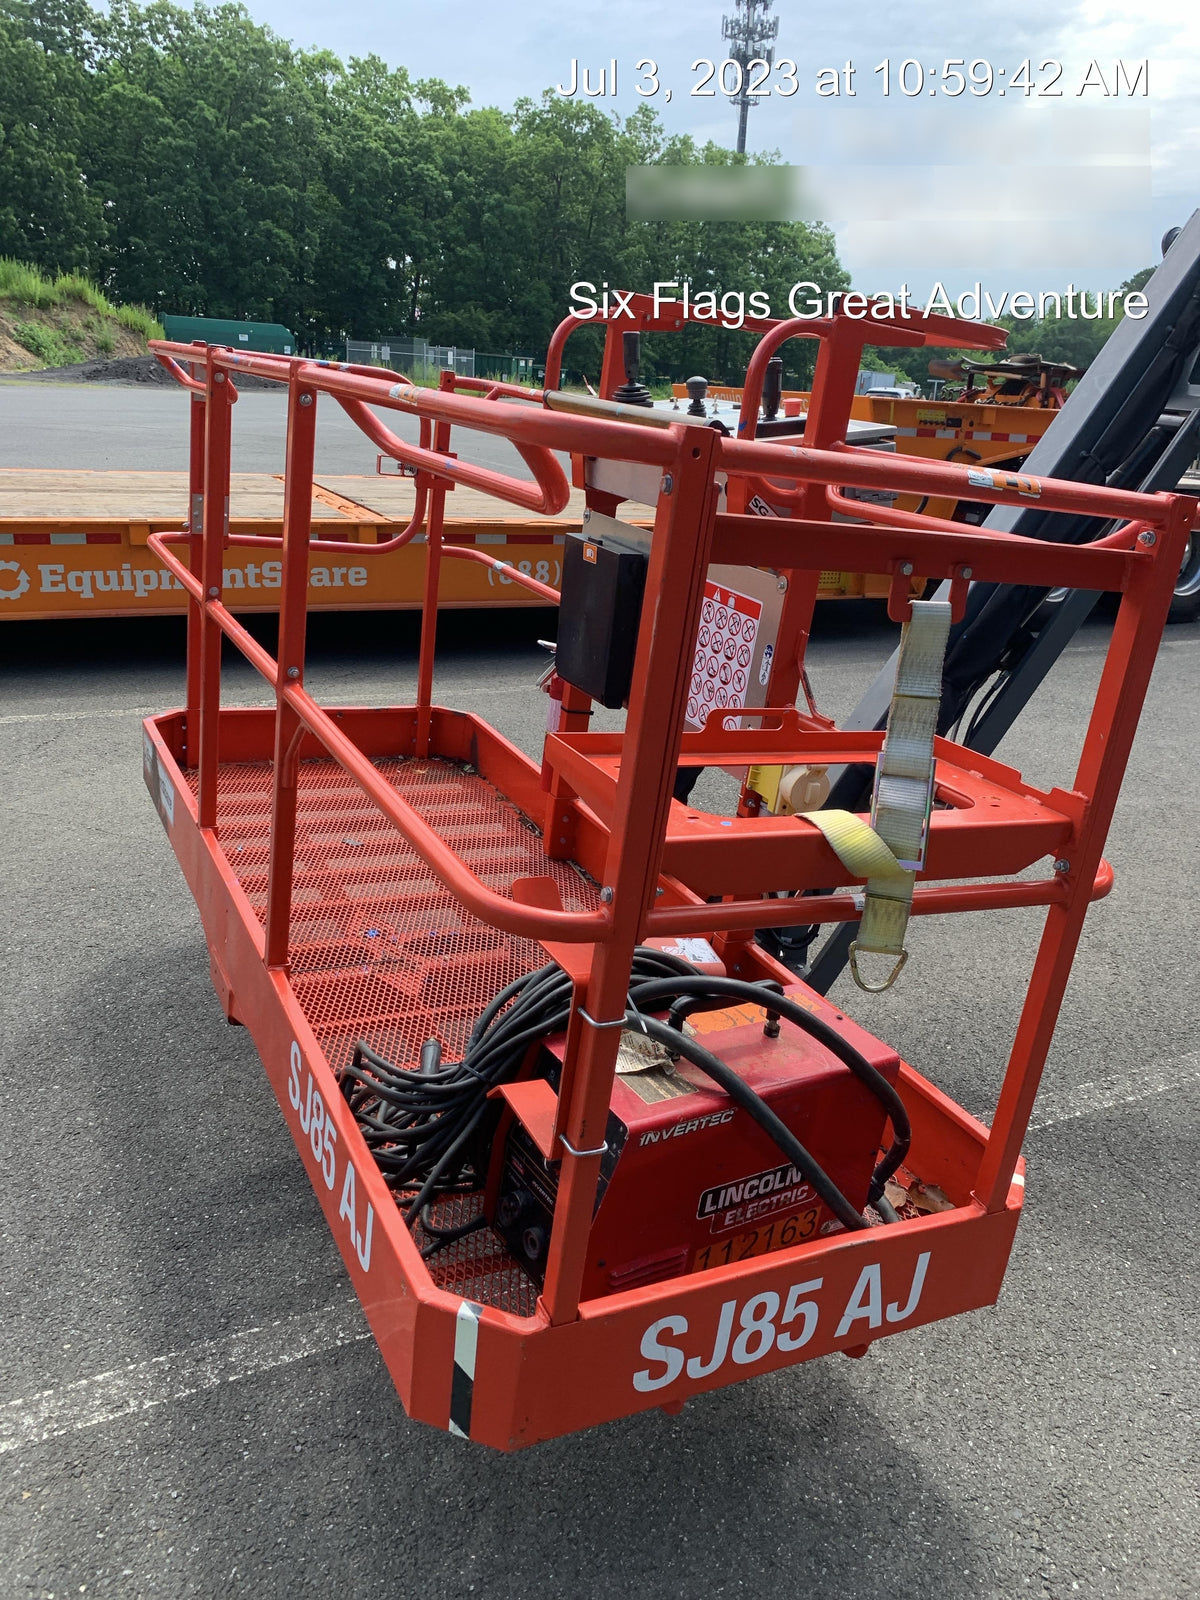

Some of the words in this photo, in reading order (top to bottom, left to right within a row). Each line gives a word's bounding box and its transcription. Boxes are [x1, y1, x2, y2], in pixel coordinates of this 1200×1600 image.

[38, 561, 369, 598] EquipntSare
[639, 1108, 736, 1147] INVERTEC
[288, 1040, 337, 1190] SJ85
[339, 1160, 374, 1273] AJ
[704, 1164, 802, 1213] LINCOLN
[723, 1186, 809, 1226] ELECTRIC
[698, 1208, 818, 1272] 112163
[632, 1277, 824, 1392] SJ85
[834, 1251, 932, 1338] AJ
